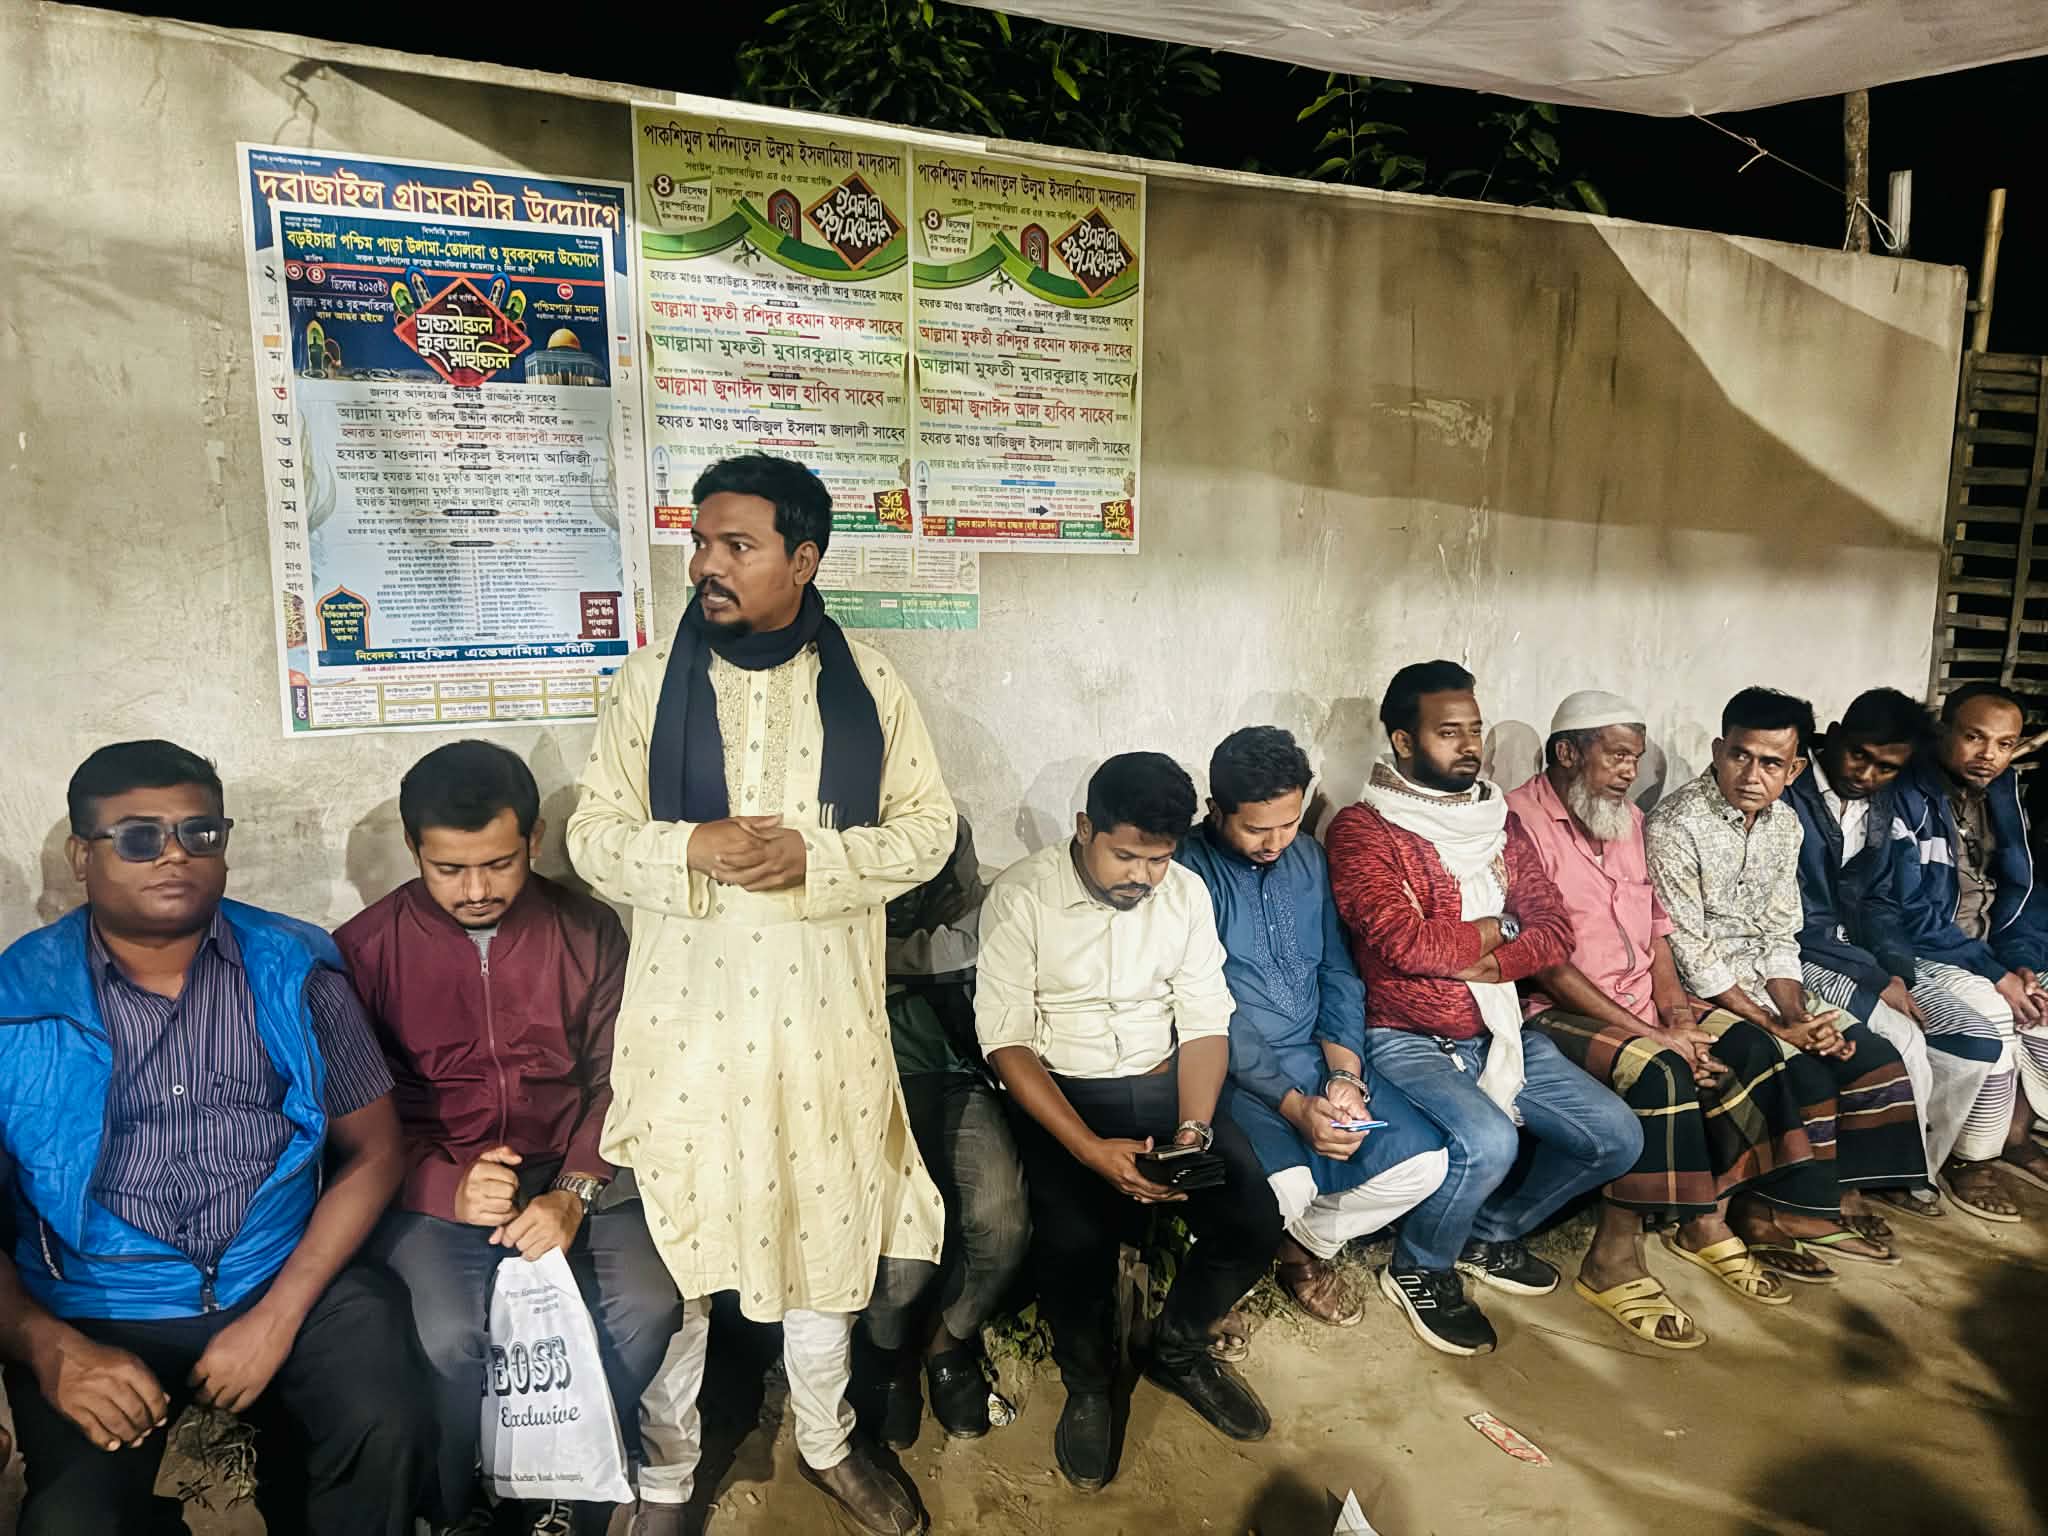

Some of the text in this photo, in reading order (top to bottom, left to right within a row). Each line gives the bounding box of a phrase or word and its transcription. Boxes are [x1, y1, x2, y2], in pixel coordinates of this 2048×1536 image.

[644, 121, 702, 154] পাকশিমুল
[706, 127, 762, 161] মদিনাতুল
[766, 136, 794, 167] উলুম
[918, 161, 968, 191] পাকশিমুল
[971, 167, 1017, 198] মদিনাতুল
[1020, 174, 1044, 203] উলুম
[392, 180, 515, 222] গ্রামবাসীর
[340, 230, 373, 251] পশ্চিম
[377, 236, 403, 256] পাড়া
[489, 247, 499, 259] ও
[345, 298, 395, 313] বৃহস্পতিবার
[786, 282, 809, 294] জনাব
[850, 288, 877, 301] তাহের
[879, 291, 904, 304] সাহেব
[650, 301, 698, 320] আল্লামা
[700, 301, 738, 322] মুফতী
[743, 304, 782, 328] রশিদুর
[785, 312, 825, 331] রহমান
[868, 318, 904, 336] সাহেব
[653, 334, 713, 355] আল্লামা
[719, 336, 767, 359] মুফতী
[858, 347, 904, 369] সাহেব
[919, 325, 957, 344] আল্লামা
[961, 327, 992, 348] মুফতী
[996, 331, 1029, 352] রশিদুর
[1033, 336, 1065, 353] রহমান
[1103, 343, 1133, 359] সাহেব
[920, 357, 970, 375] আল্লামা
[974, 360, 1016, 380] মুফতী
[1093, 372, 1131, 389] সাহেব
[369, 388, 399, 399] জনাব
[525, 394, 556, 403] সাহেব
[655, 375, 885, 409] আল্লামা জুনাঈদ আল হাবিব সাহেব
[337, 408, 382, 421] আল্লামা
[386, 407, 422, 423] মুফতি
[491, 411, 525, 424] কাসেমী
[528, 415, 558, 426] সাহেব
[920, 395, 1114, 425] আল্লামা জুনাঈদ আল হাবিব সাহেব
[380, 429, 426, 439] মাওলানা
[551, 433, 584, 444] সাহেব
[656, 414, 695, 430] হযরত
[732, 415, 783, 436] আজিজুল
[786, 418, 826, 437] ইসলাম
[829, 421, 868, 439] জালালী
[872, 426, 906, 441] সাহেব
[336, 449, 378, 460] হযরত
[381, 450, 437, 462] মাওলানা
[443, 448, 490, 463] শফিকুল
[497, 450, 539, 463] ইসলাম
[920, 431, 952, 447] হযরত
[983, 432, 1026, 451] আজিজুল
[1029, 435, 1063, 453] ইসলাম
[1065, 437, 1100, 454] জালালী
[1102, 441, 1131, 456] সাহেব
[399, 647, 458, 662] মাহফিল
[552, 641, 596, 656] কমিটি
[501, 1404, 581, 1428] Exclusive
